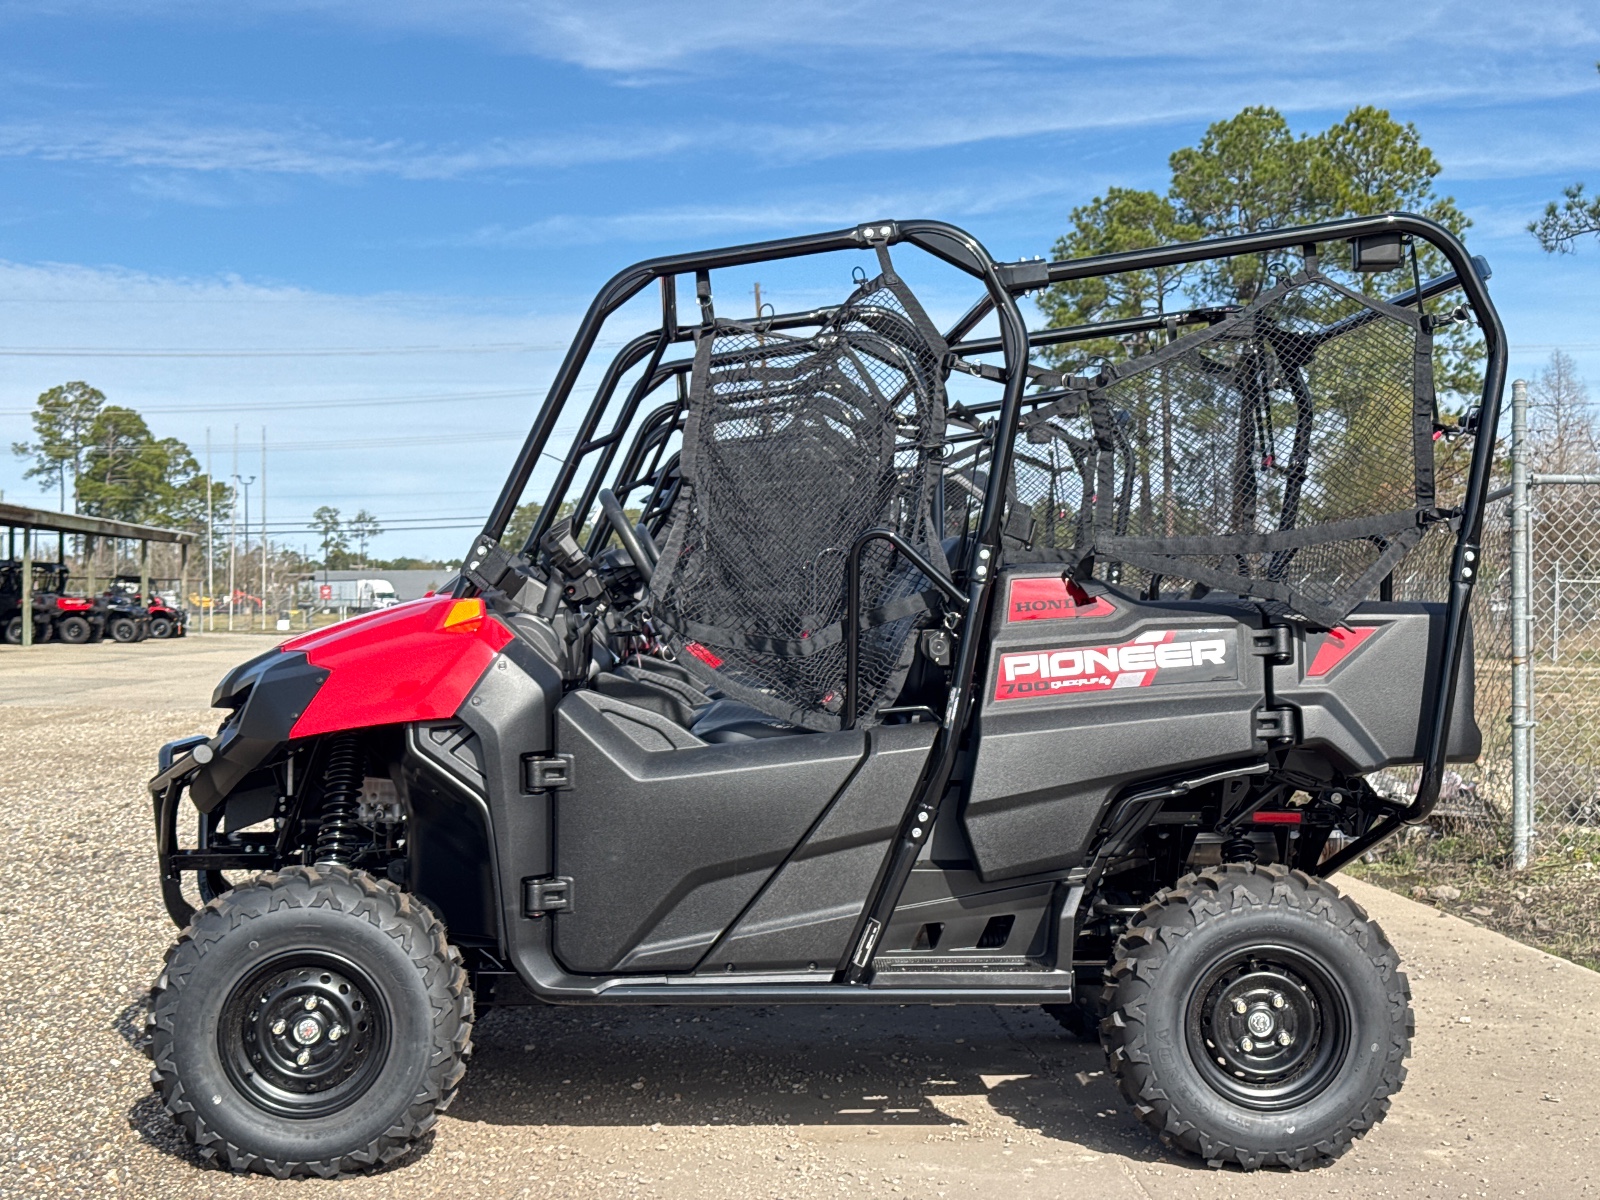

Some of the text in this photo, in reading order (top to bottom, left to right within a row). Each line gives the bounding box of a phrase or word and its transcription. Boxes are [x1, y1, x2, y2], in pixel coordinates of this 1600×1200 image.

[1015, 598, 1075, 613] HOND
[1003, 639, 1227, 682] PIONEER
[1001, 681, 1050, 694] 700
[1153, 1028, 1210, 1117] KENDA
